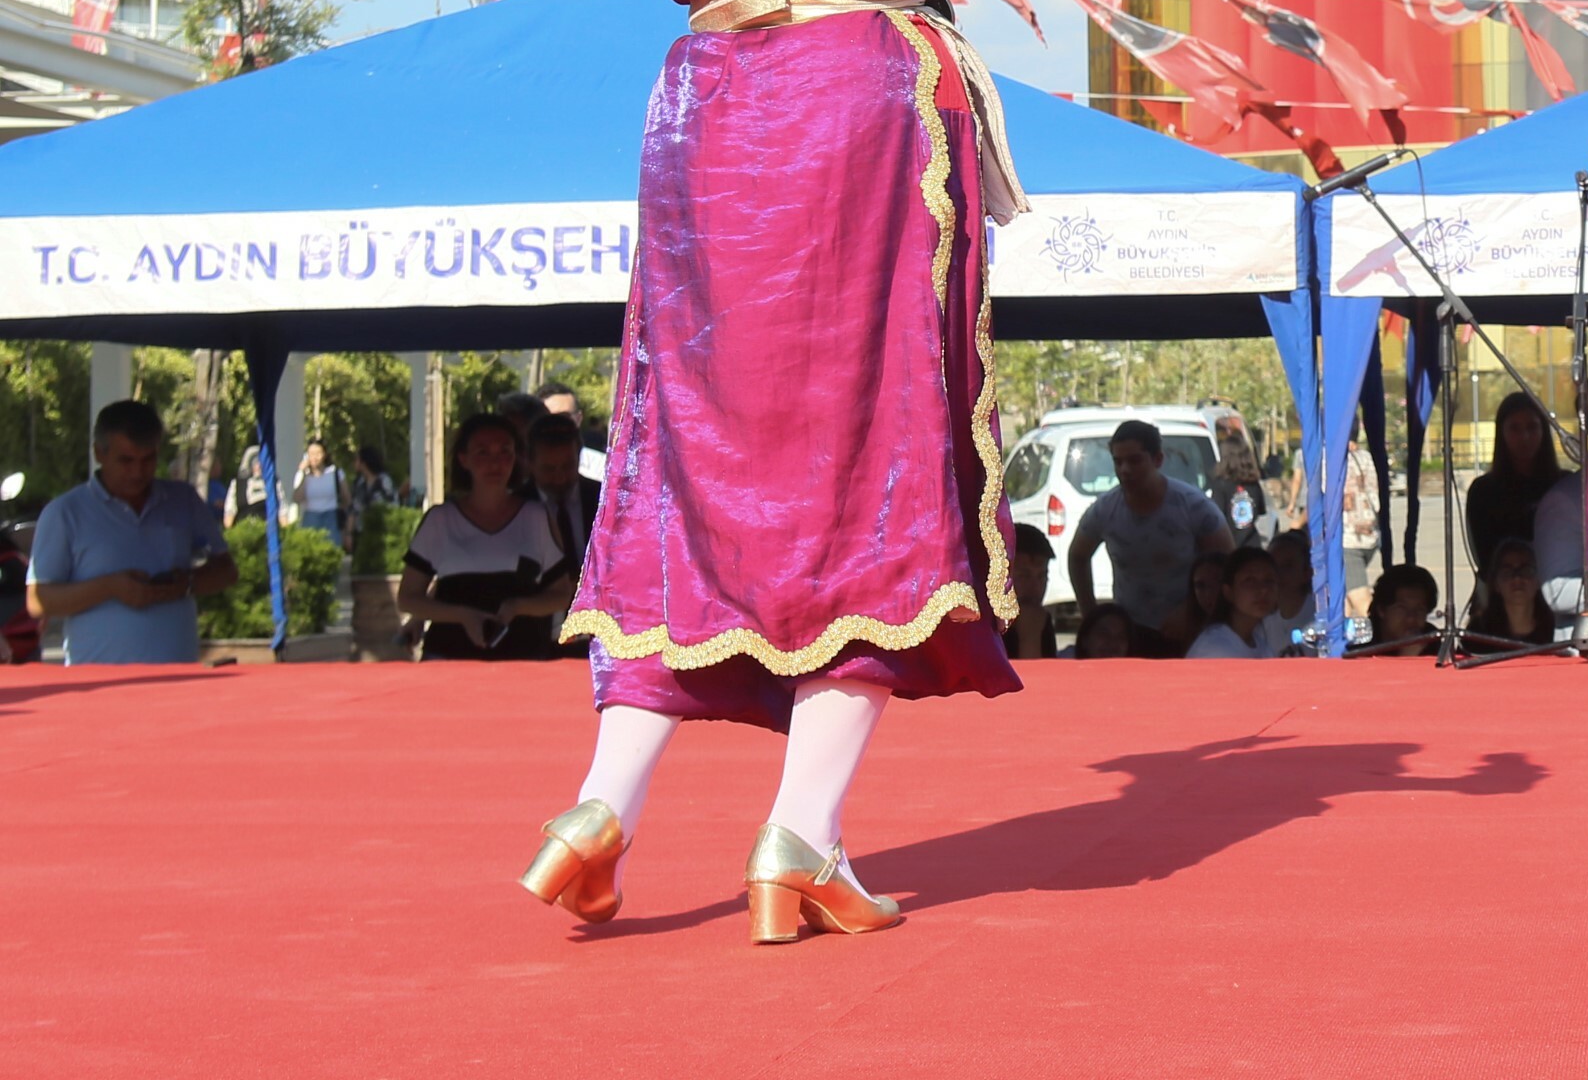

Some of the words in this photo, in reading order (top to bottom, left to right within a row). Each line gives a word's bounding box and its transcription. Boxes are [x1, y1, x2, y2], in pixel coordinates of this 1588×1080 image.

[1147, 228, 1189, 241] AYDIN
[1521, 227, 1563, 241] AYDIN
[33, 244, 109, 285] T.C.
[127, 241, 277, 283] AYDIN
[1129, 264, 1205, 280] BELEDİYESİ
